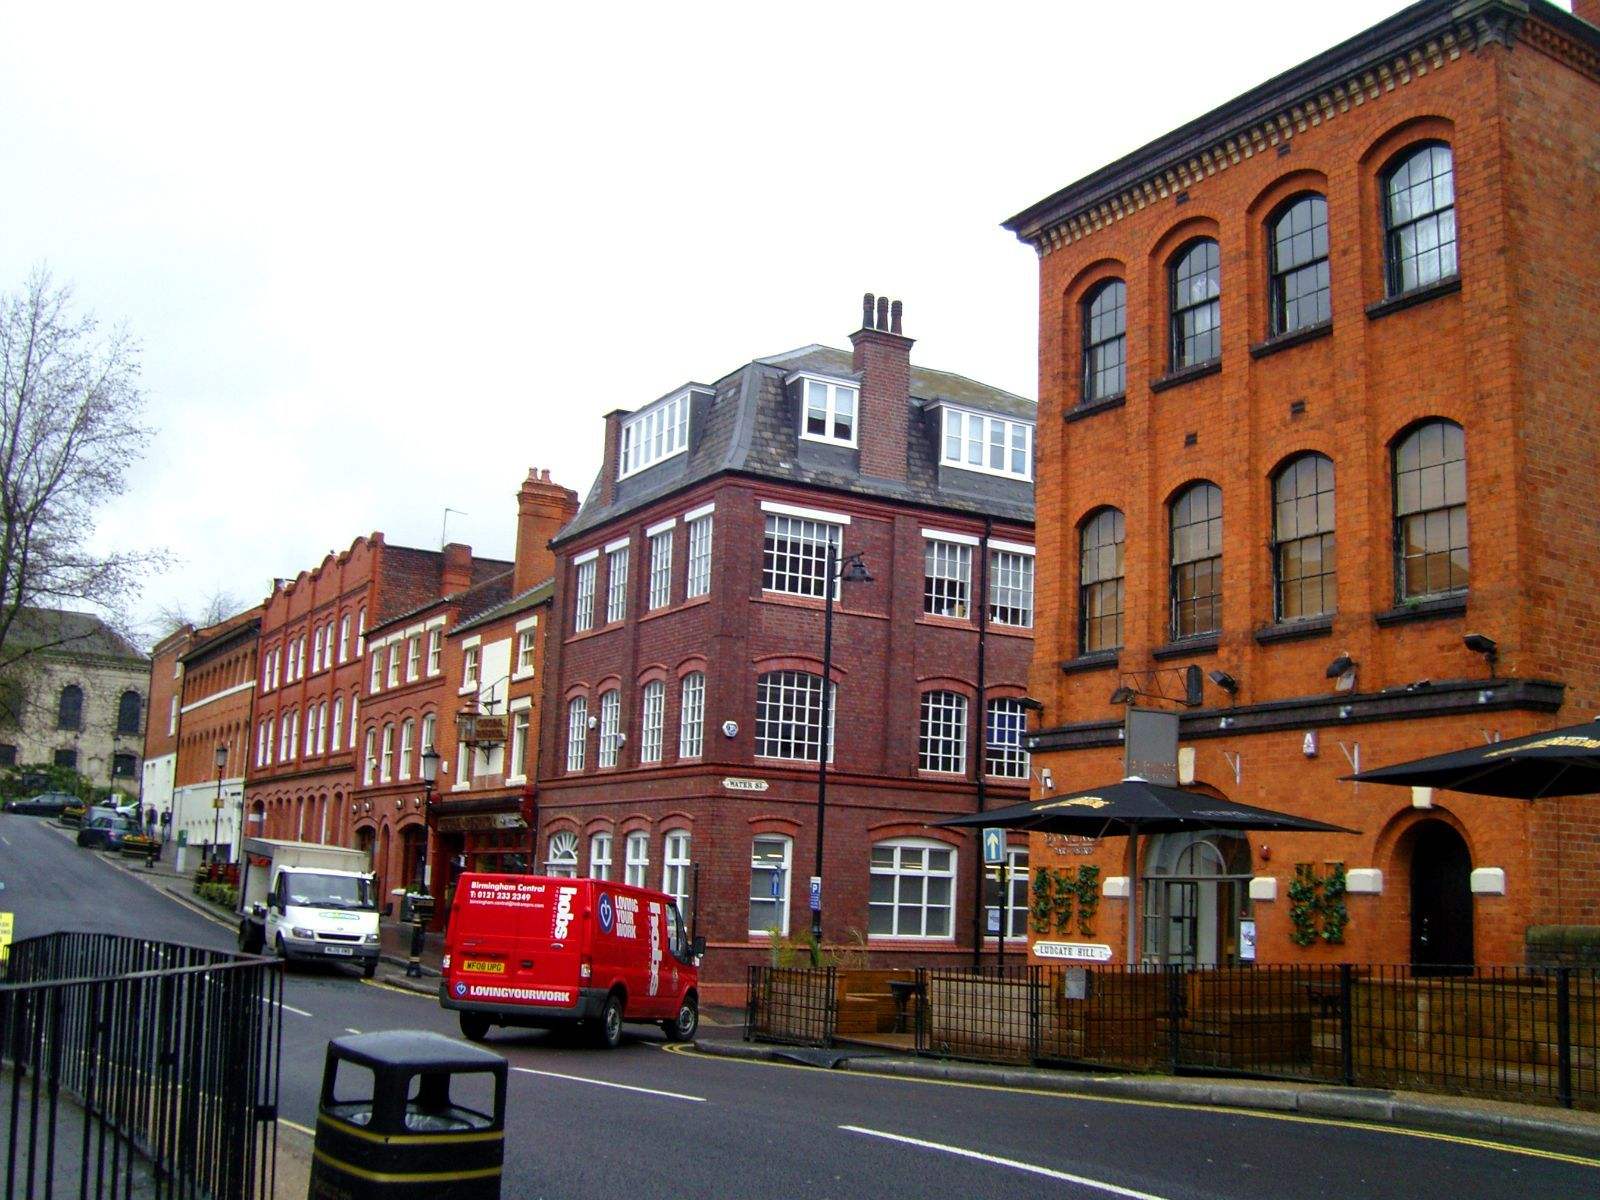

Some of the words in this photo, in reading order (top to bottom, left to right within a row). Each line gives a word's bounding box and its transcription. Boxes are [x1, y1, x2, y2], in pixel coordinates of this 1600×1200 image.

[730, 780, 753, 789] WATER
[471, 881, 516, 892] Birmingham
[517, 883, 545, 892] Central
[477, 891, 495, 899] 0121
[496, 892, 511, 900] 233
[615, 895, 639, 913] LOVING
[555, 886, 578, 939] hobs
[616, 909, 635, 925] YOUR
[616, 923, 637, 939] WORK
[649, 902, 663, 996] hobs
[1040, 945, 1073, 956] LUDGATE
[1077, 947, 1095, 957] HILL
[470, 985, 570, 1002] LOVINGYOURWORK
